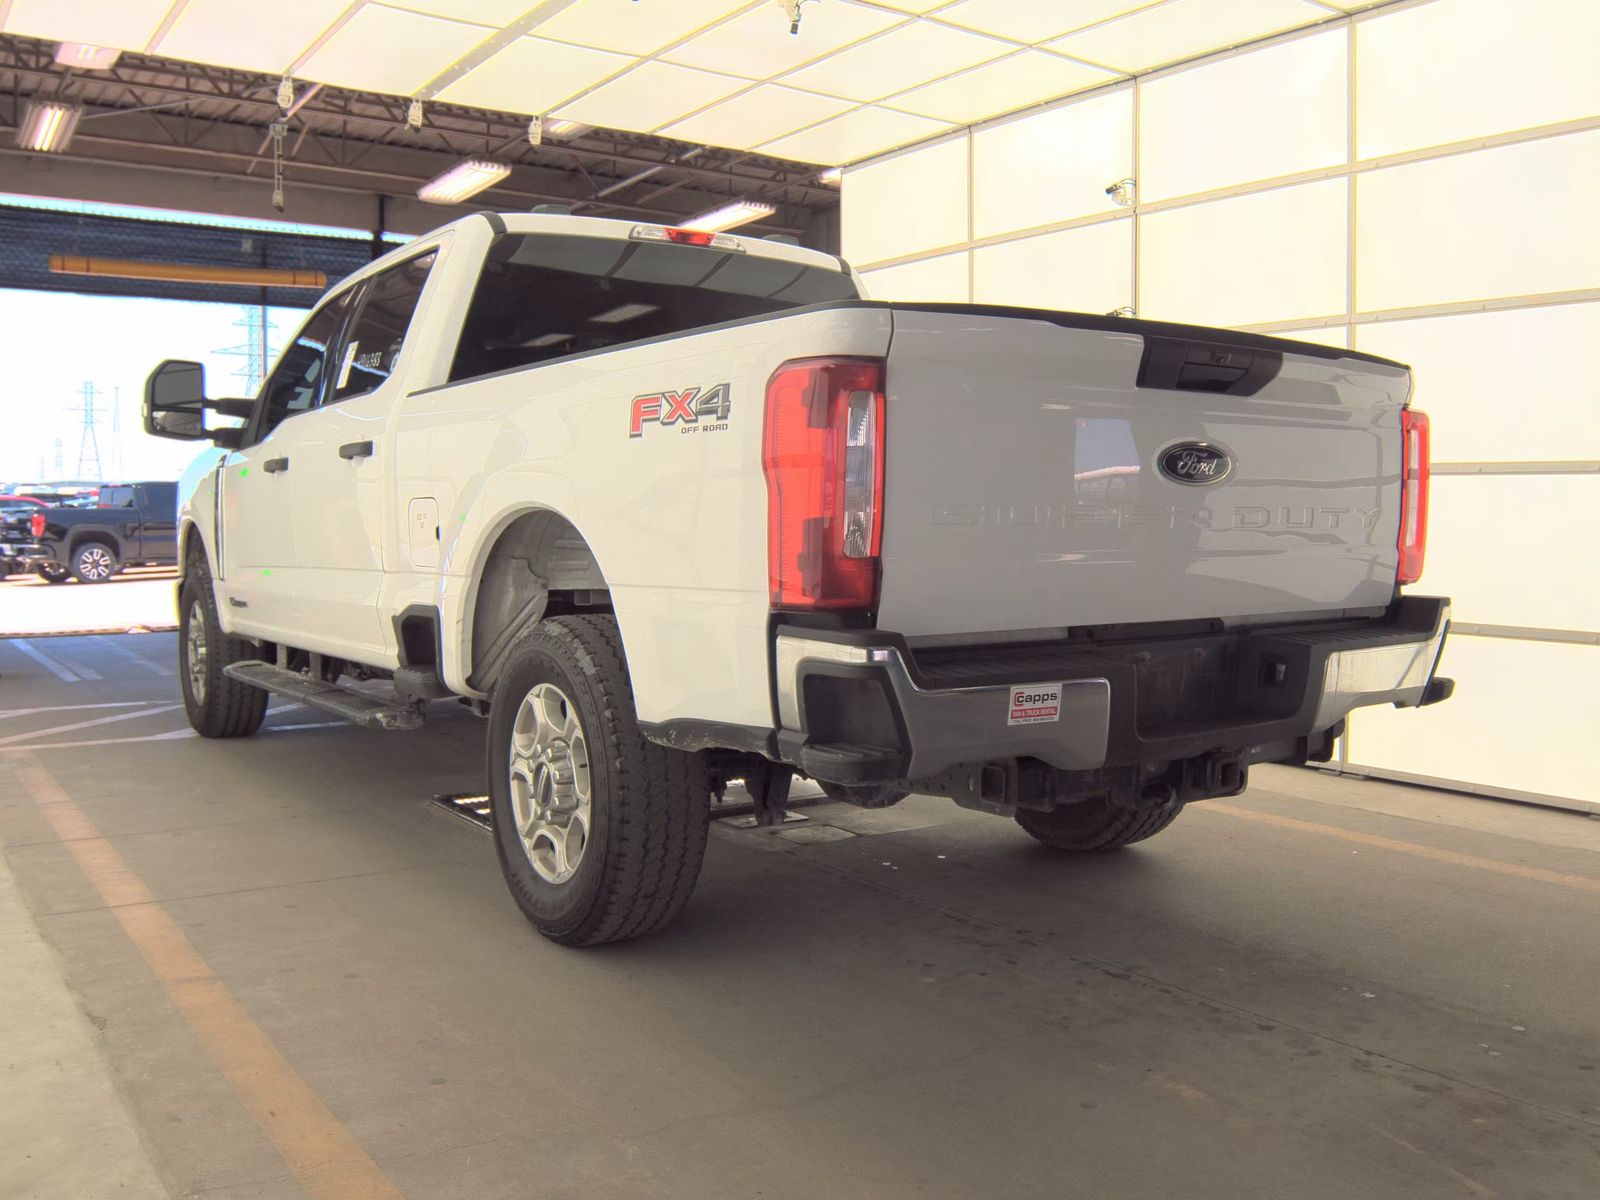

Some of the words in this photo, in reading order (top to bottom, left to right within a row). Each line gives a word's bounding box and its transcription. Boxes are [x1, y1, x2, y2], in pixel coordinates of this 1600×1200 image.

[629, 383, 731, 438] FX4
[681, 426, 699, 434] OFF
[702, 423, 728, 432] ROAD
[1177, 451, 1217, 474] Ford
[928, 504, 1213, 530] SUPER
[1232, 506, 1383, 530] DUTY
